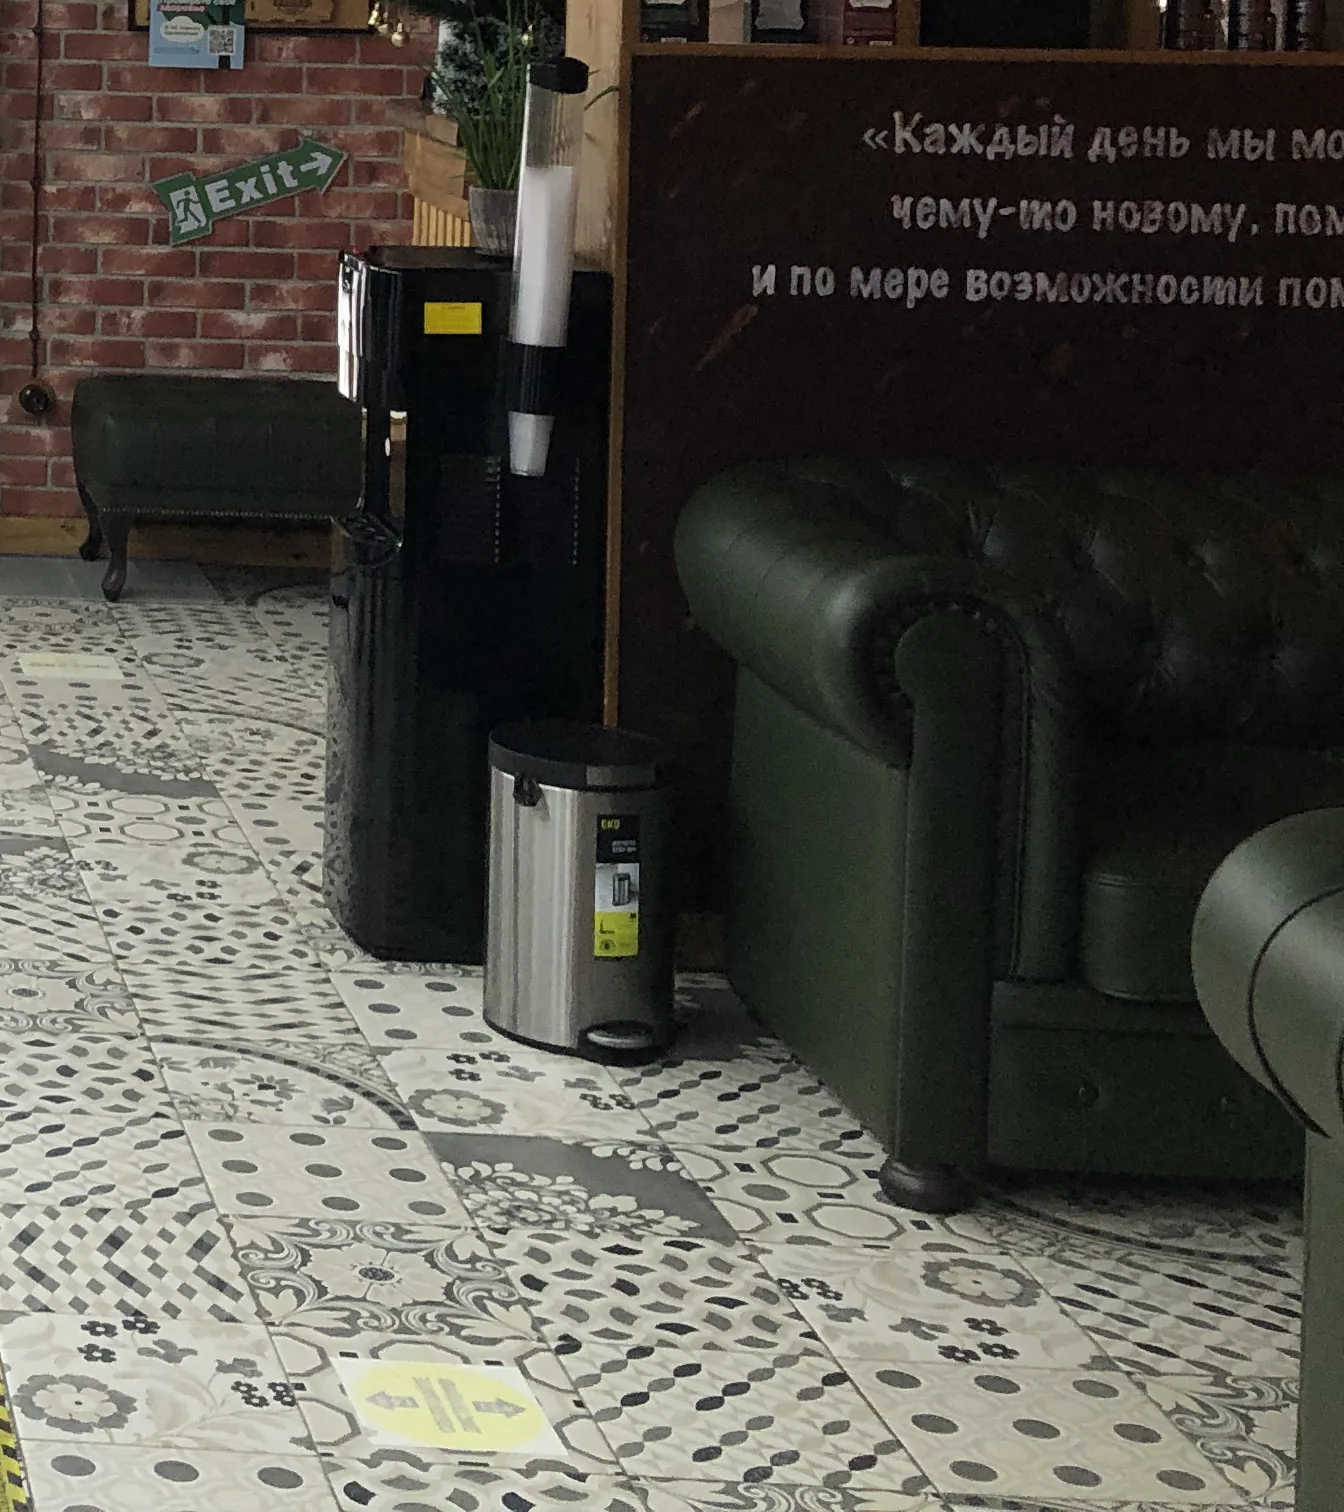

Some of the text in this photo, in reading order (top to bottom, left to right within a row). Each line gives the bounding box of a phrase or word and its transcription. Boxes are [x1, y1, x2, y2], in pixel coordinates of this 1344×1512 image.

[863, 111, 1075, 161] «Каждый
[1088, 125, 1191, 163] день
[1207, 127, 1276, 162] мы
[206, 158, 299, 215] Exit
[890, 194, 1078, 239] чему-то
[1092, 199, 1261, 242] новому,
[752, 264, 777, 296] и
[790, 265, 836, 297] по
[850, 266, 951, 308] мере
[965, 268, 1265, 305] возможности
